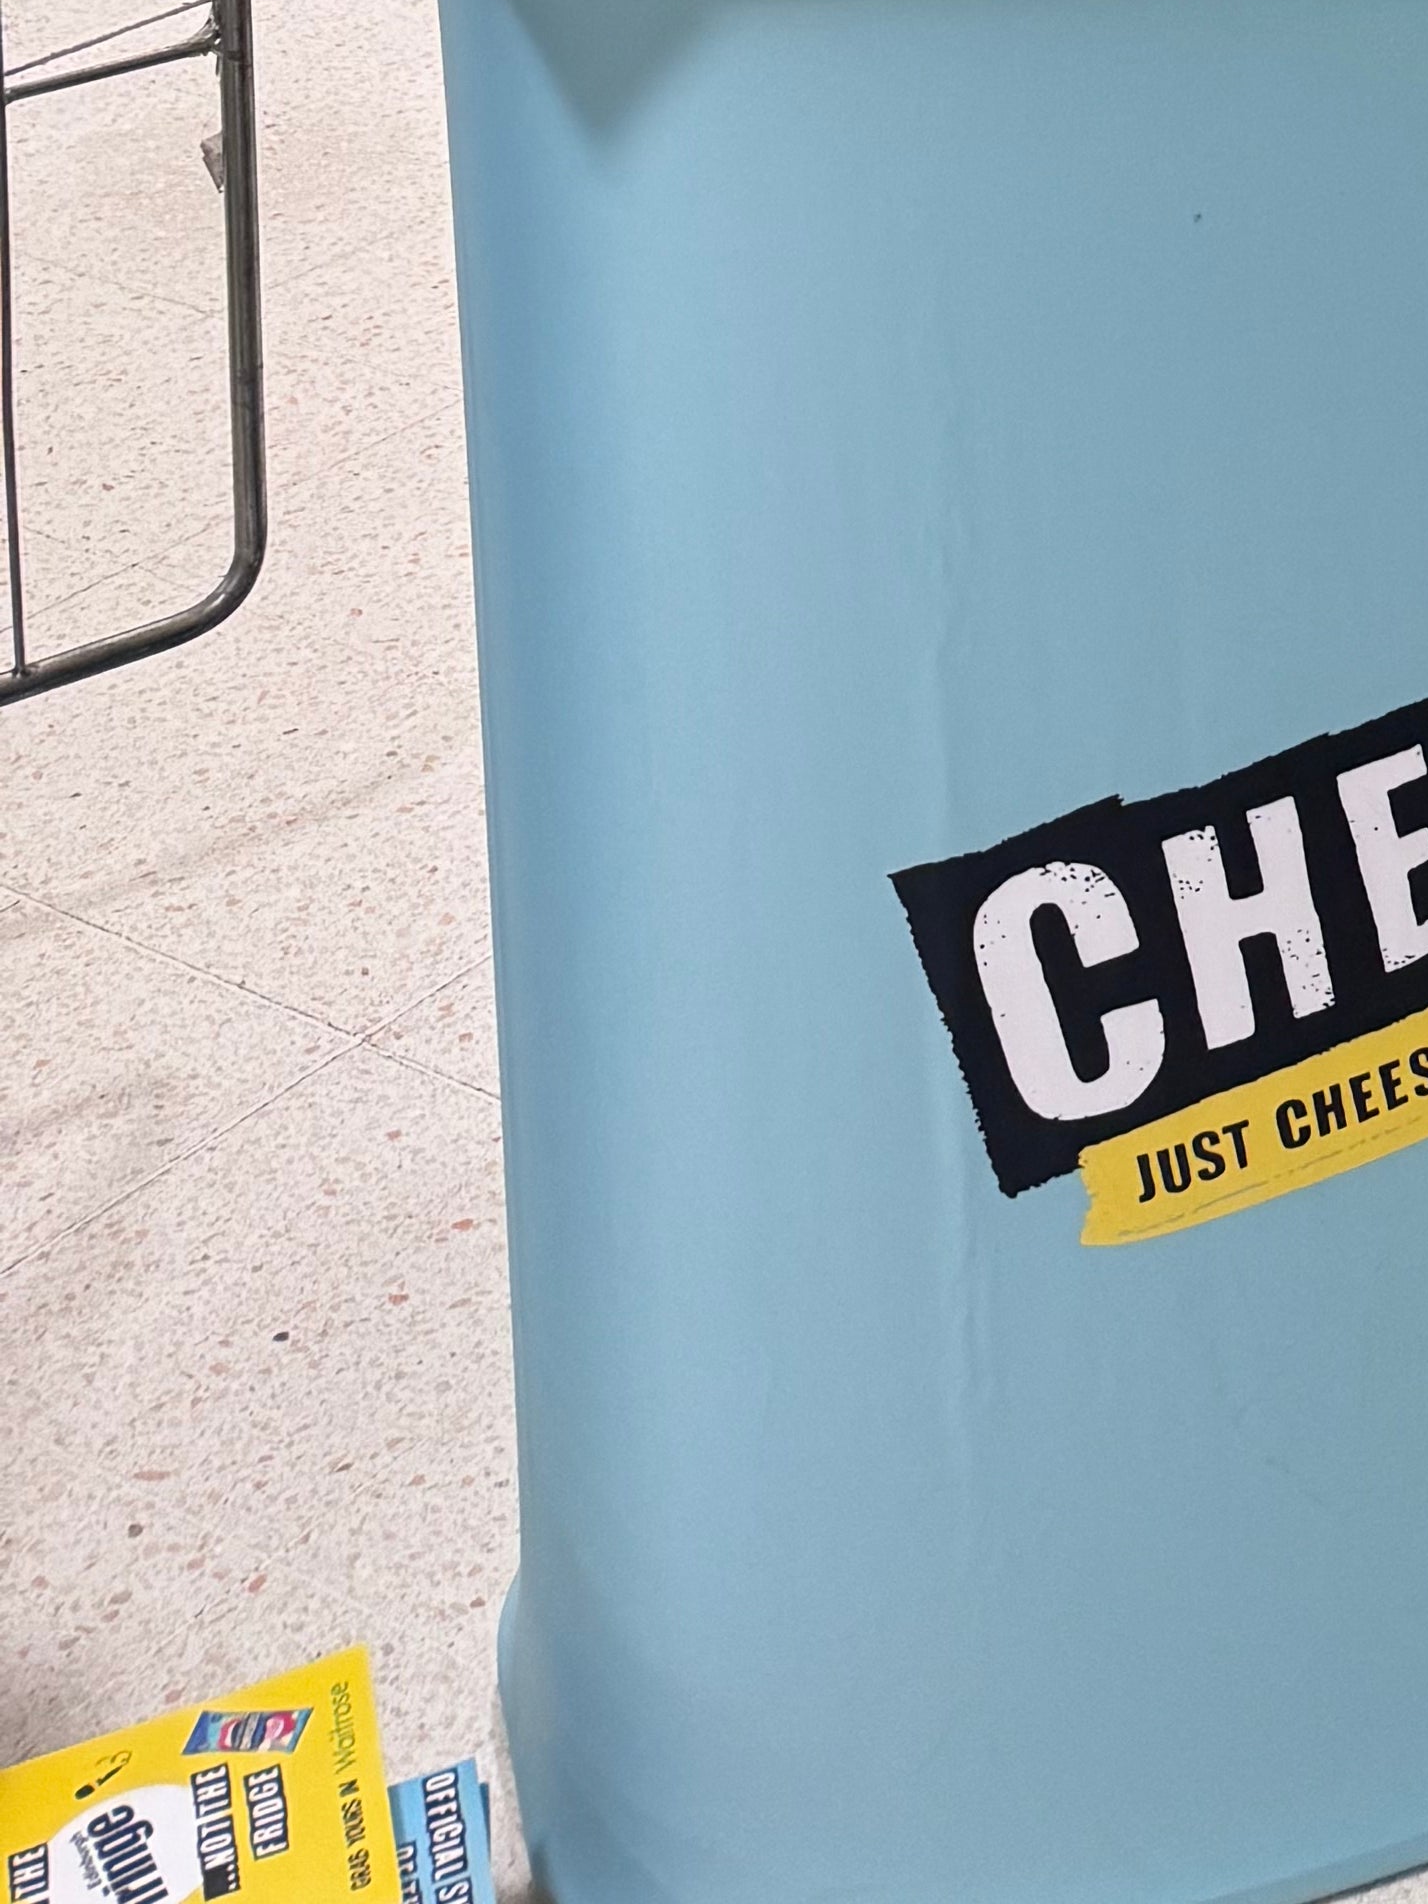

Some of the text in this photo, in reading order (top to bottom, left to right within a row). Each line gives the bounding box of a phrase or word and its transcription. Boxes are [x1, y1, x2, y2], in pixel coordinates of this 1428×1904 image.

[1135, 1118, 1253, 1206] JUST
[328, 1680, 357, 1775] Waitrose
[195, 1765, 230, 1820] THE
[250, 1769, 288, 1857] FRIDGE
[425, 1771, 467, 1881] OFFICIAL
[13, 1845, 47, 1899] THE
[84, 1804, 171, 1904] ringe
